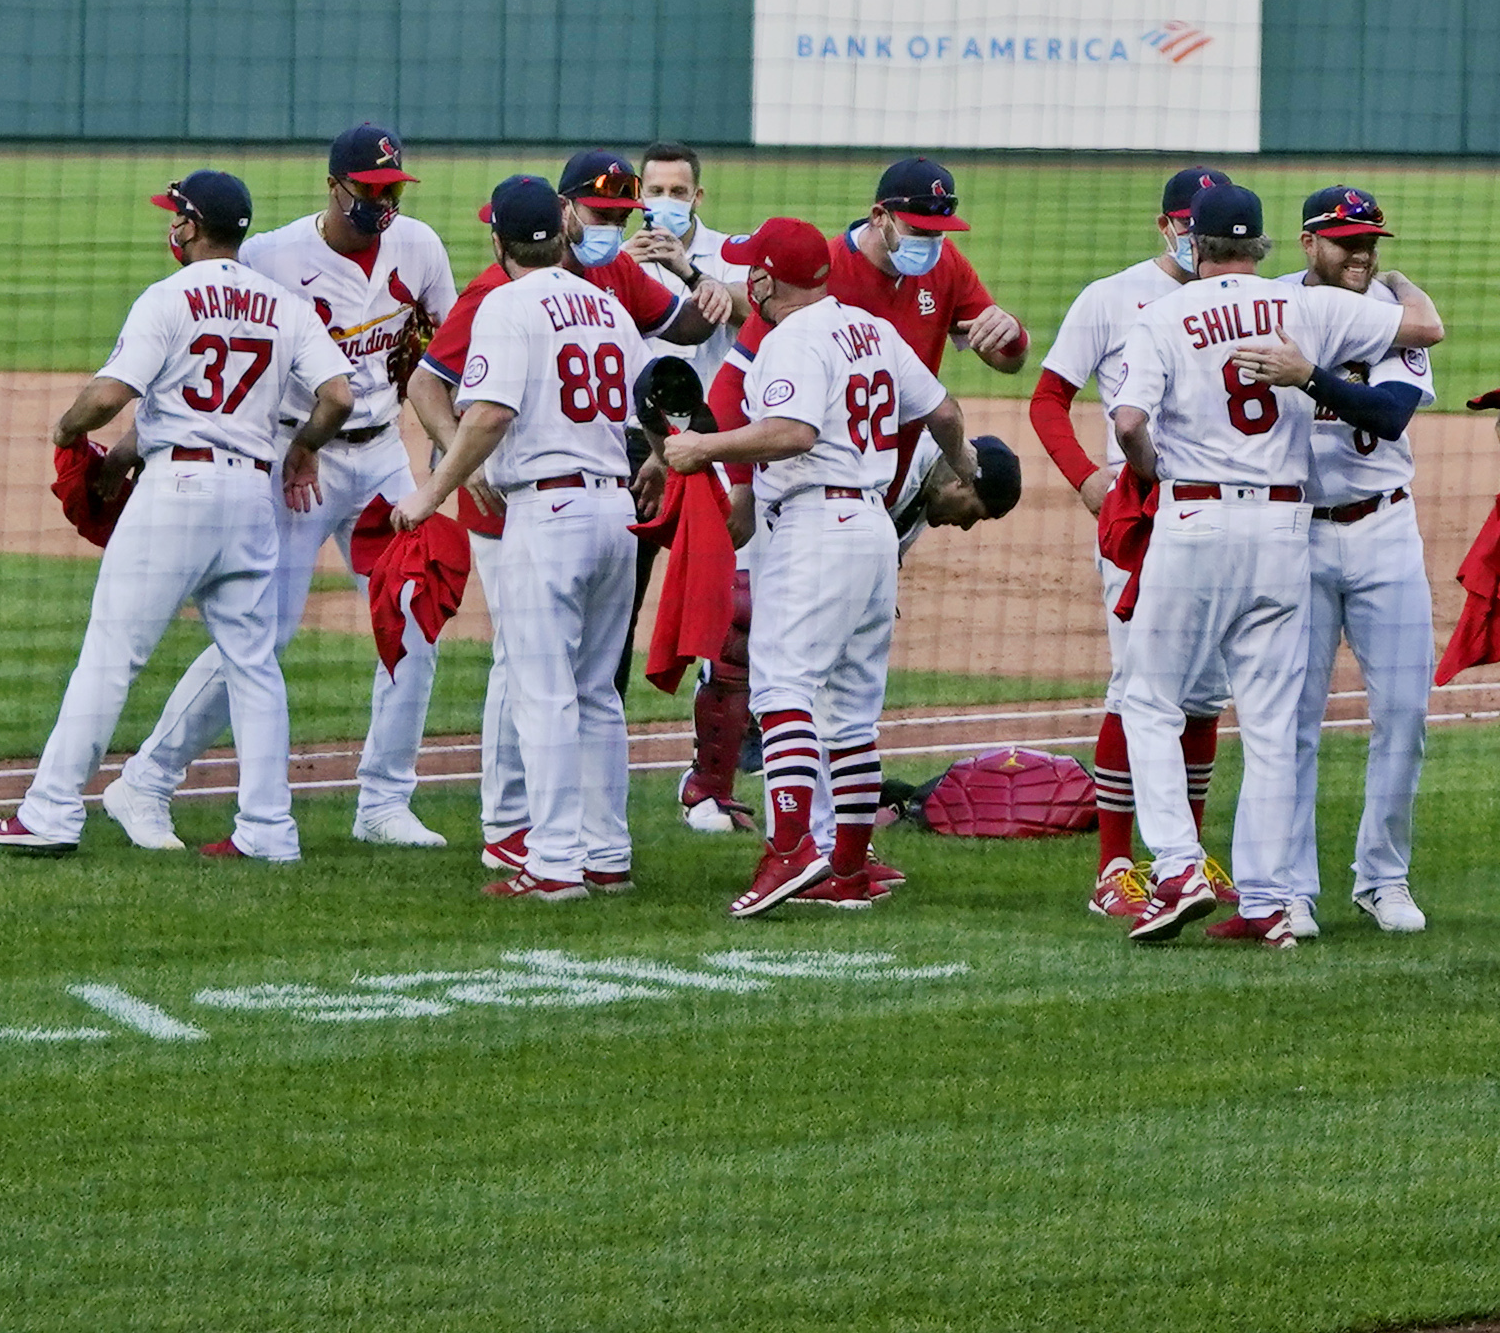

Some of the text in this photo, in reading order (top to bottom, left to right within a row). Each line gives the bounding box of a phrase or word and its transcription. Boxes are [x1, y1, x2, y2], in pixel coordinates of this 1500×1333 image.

[796, 33, 1130, 62] BANK OF AMERICA
[184, 286, 279, 329] MARMOL
[540, 291, 616, 333] ELKINS
[1183, 299, 1288, 349] SHILDT
[832, 330, 882, 363] CLAPP
[182, 334, 273, 414] 37
[466, 361, 486, 382] 20
[556, 343, 627, 423] 88
[765, 383, 793, 403] 20
[845, 369, 900, 454] 82
[1221, 355, 1280, 436] 8
